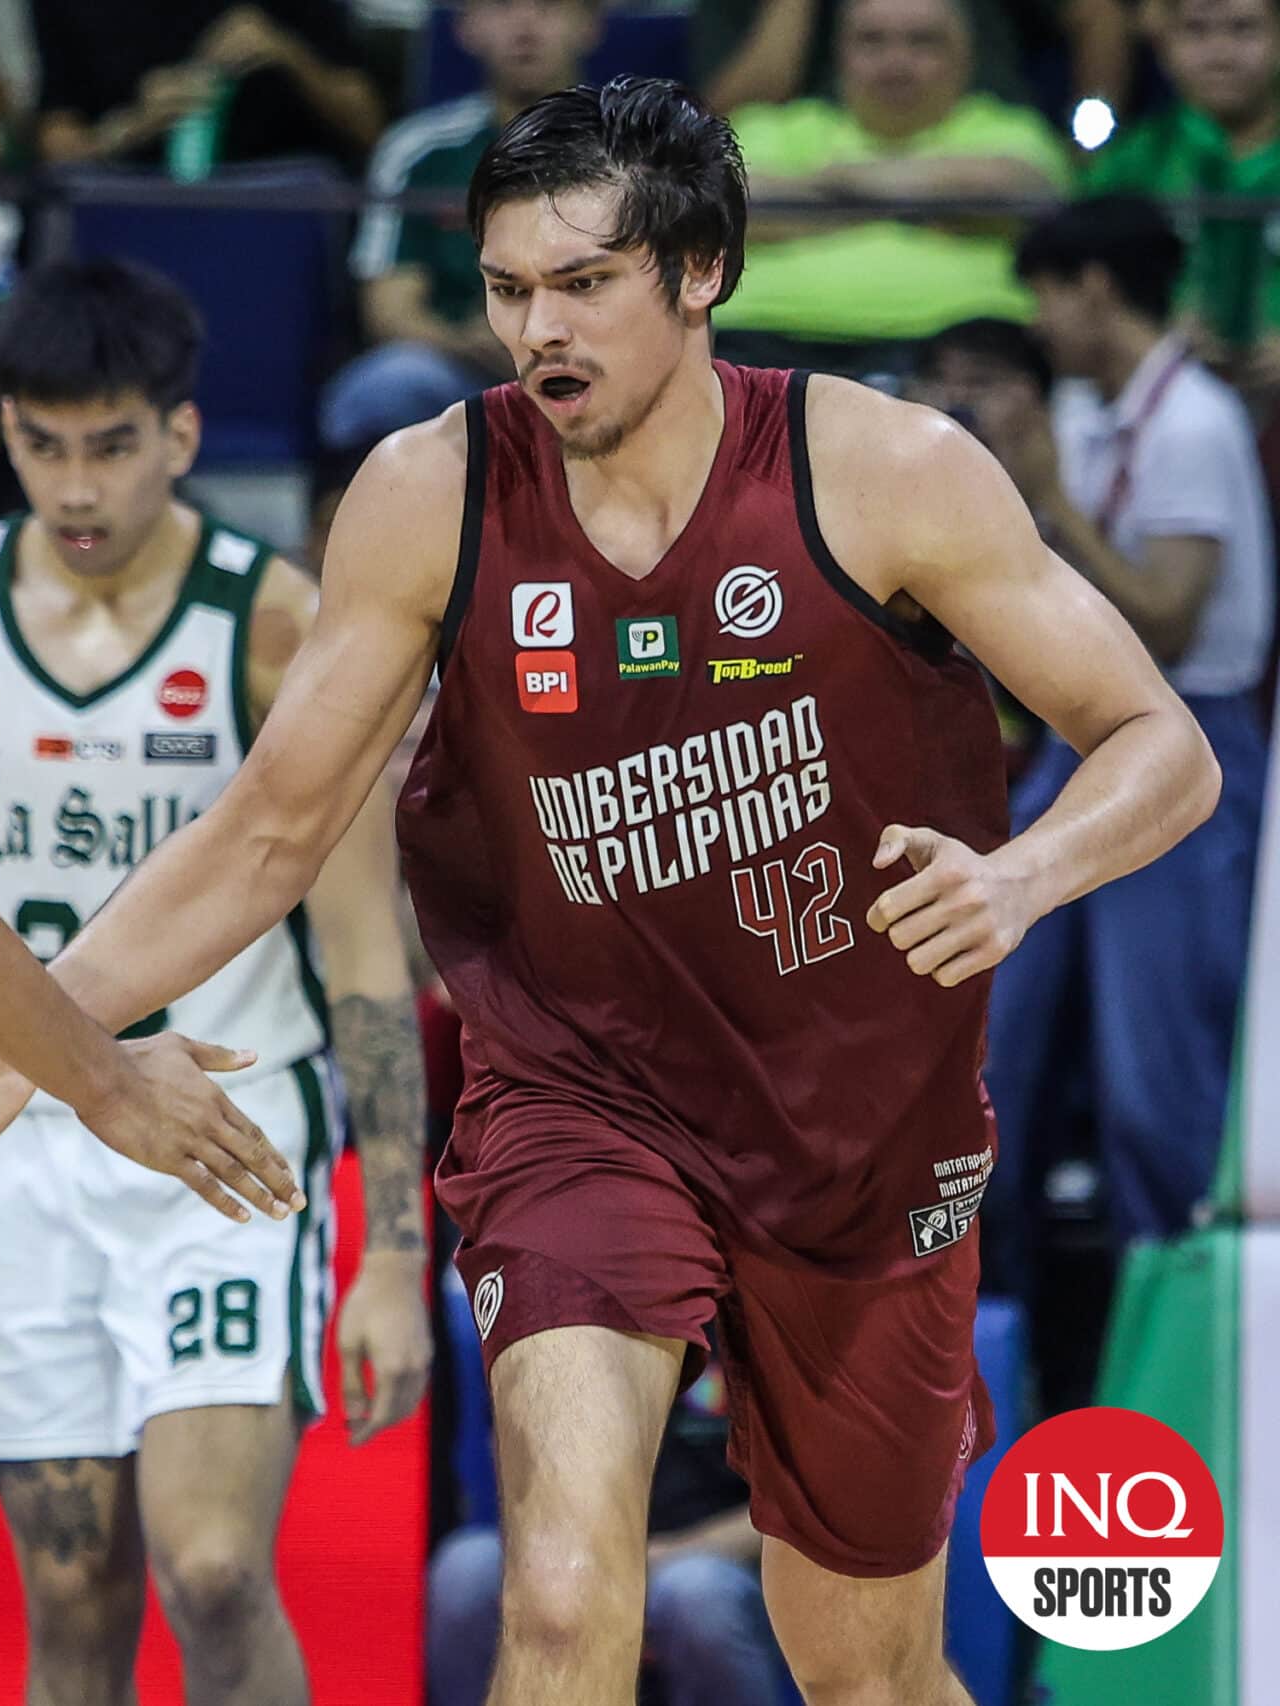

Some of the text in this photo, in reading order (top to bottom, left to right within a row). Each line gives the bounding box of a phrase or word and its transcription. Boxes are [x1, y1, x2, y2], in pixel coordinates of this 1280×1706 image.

[525, 671, 568, 693] BPI
[619, 658, 680, 675] PalawanPay
[528, 694, 825, 841] UNIBERSIDAD
[49, 785, 201, 869] Sall
[546, 759, 832, 906] NG PILIPINAS
[730, 840, 855, 977] 42
[166, 1277, 259, 1368] 28
